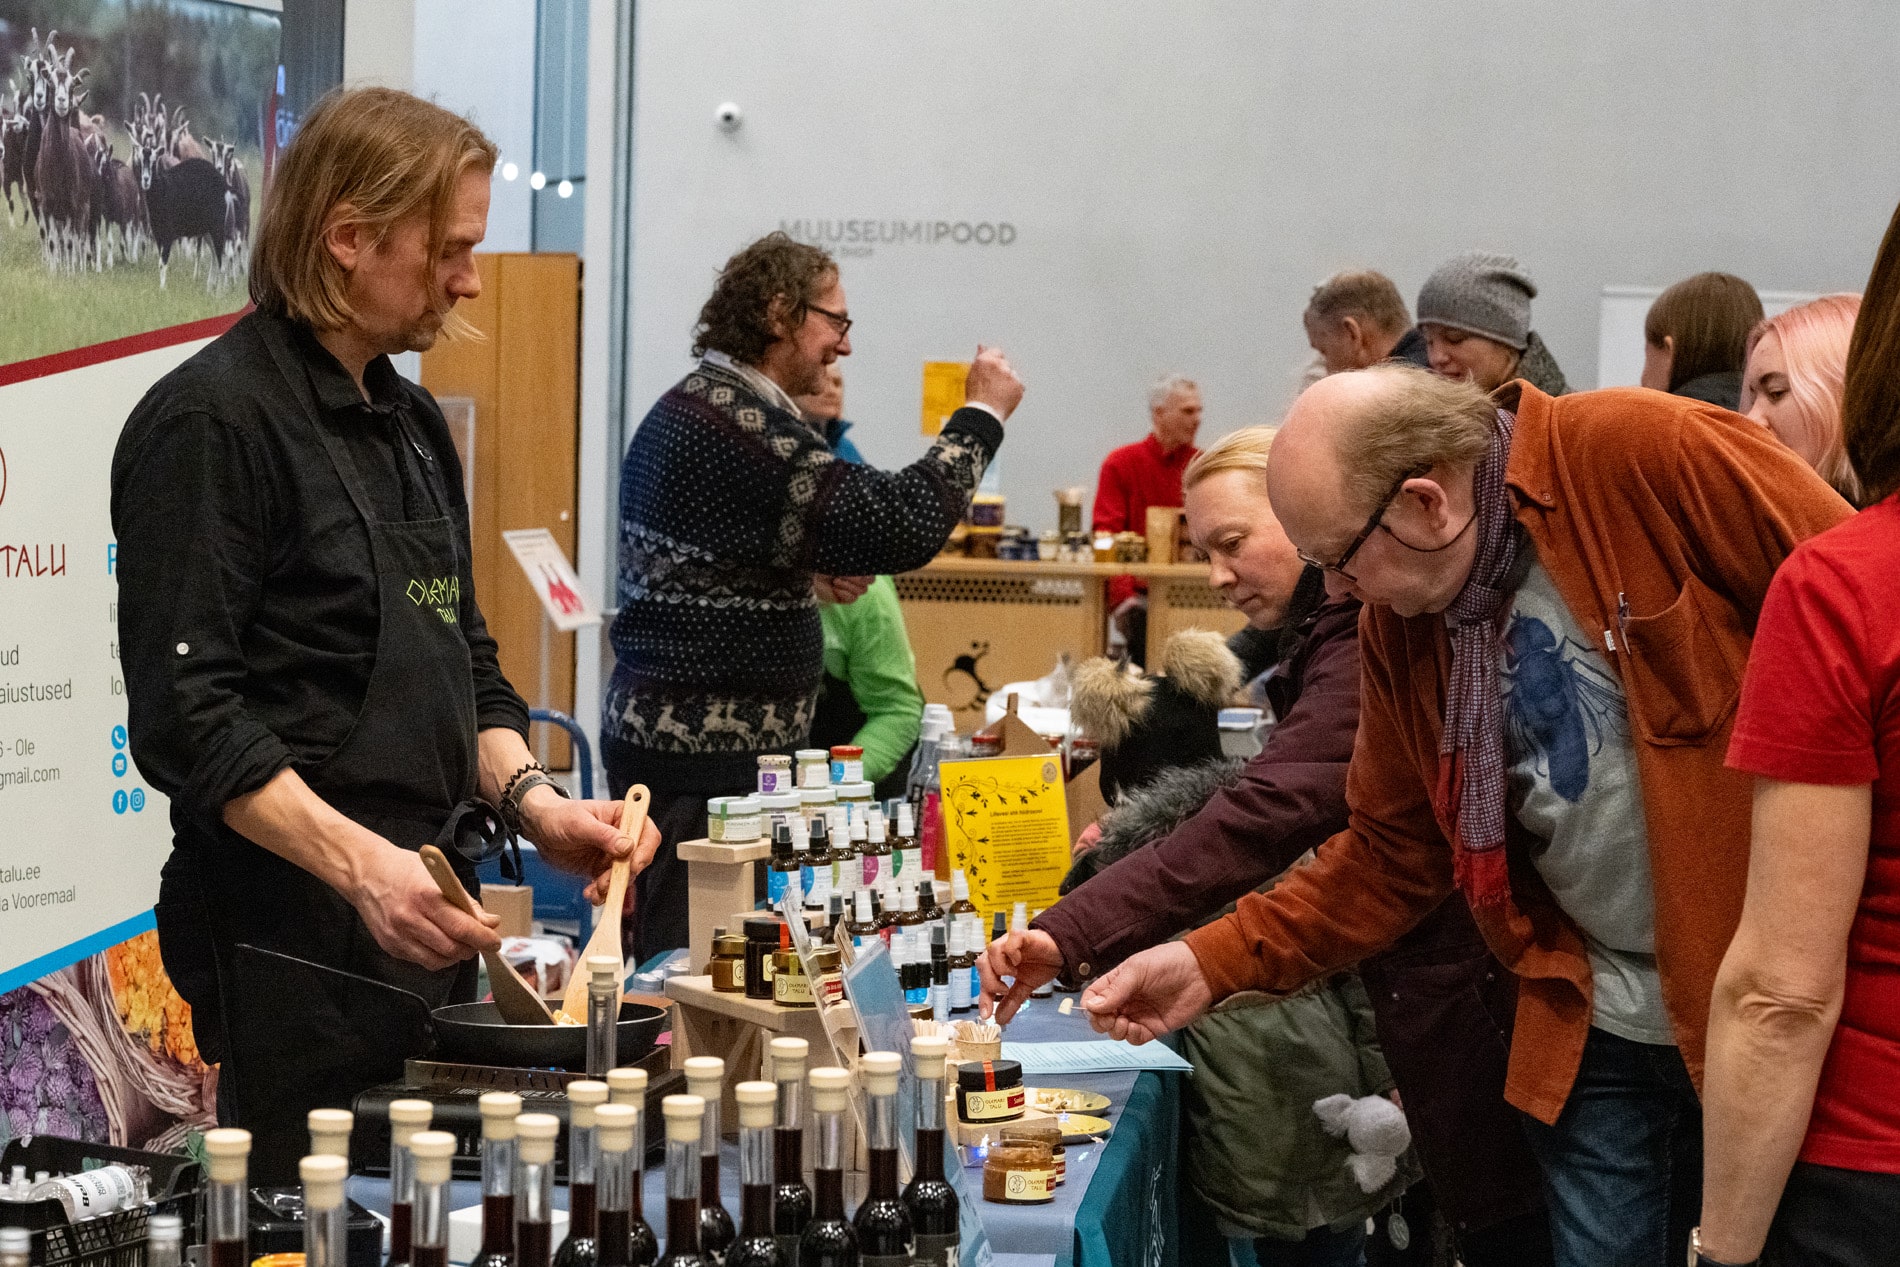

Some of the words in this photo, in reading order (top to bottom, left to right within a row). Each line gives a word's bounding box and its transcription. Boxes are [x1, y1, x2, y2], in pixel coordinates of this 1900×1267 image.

[0, 544, 65, 578] TALU
[15, 738, 35, 757] Ole
[12, 885, 76, 910] Vooremaal
